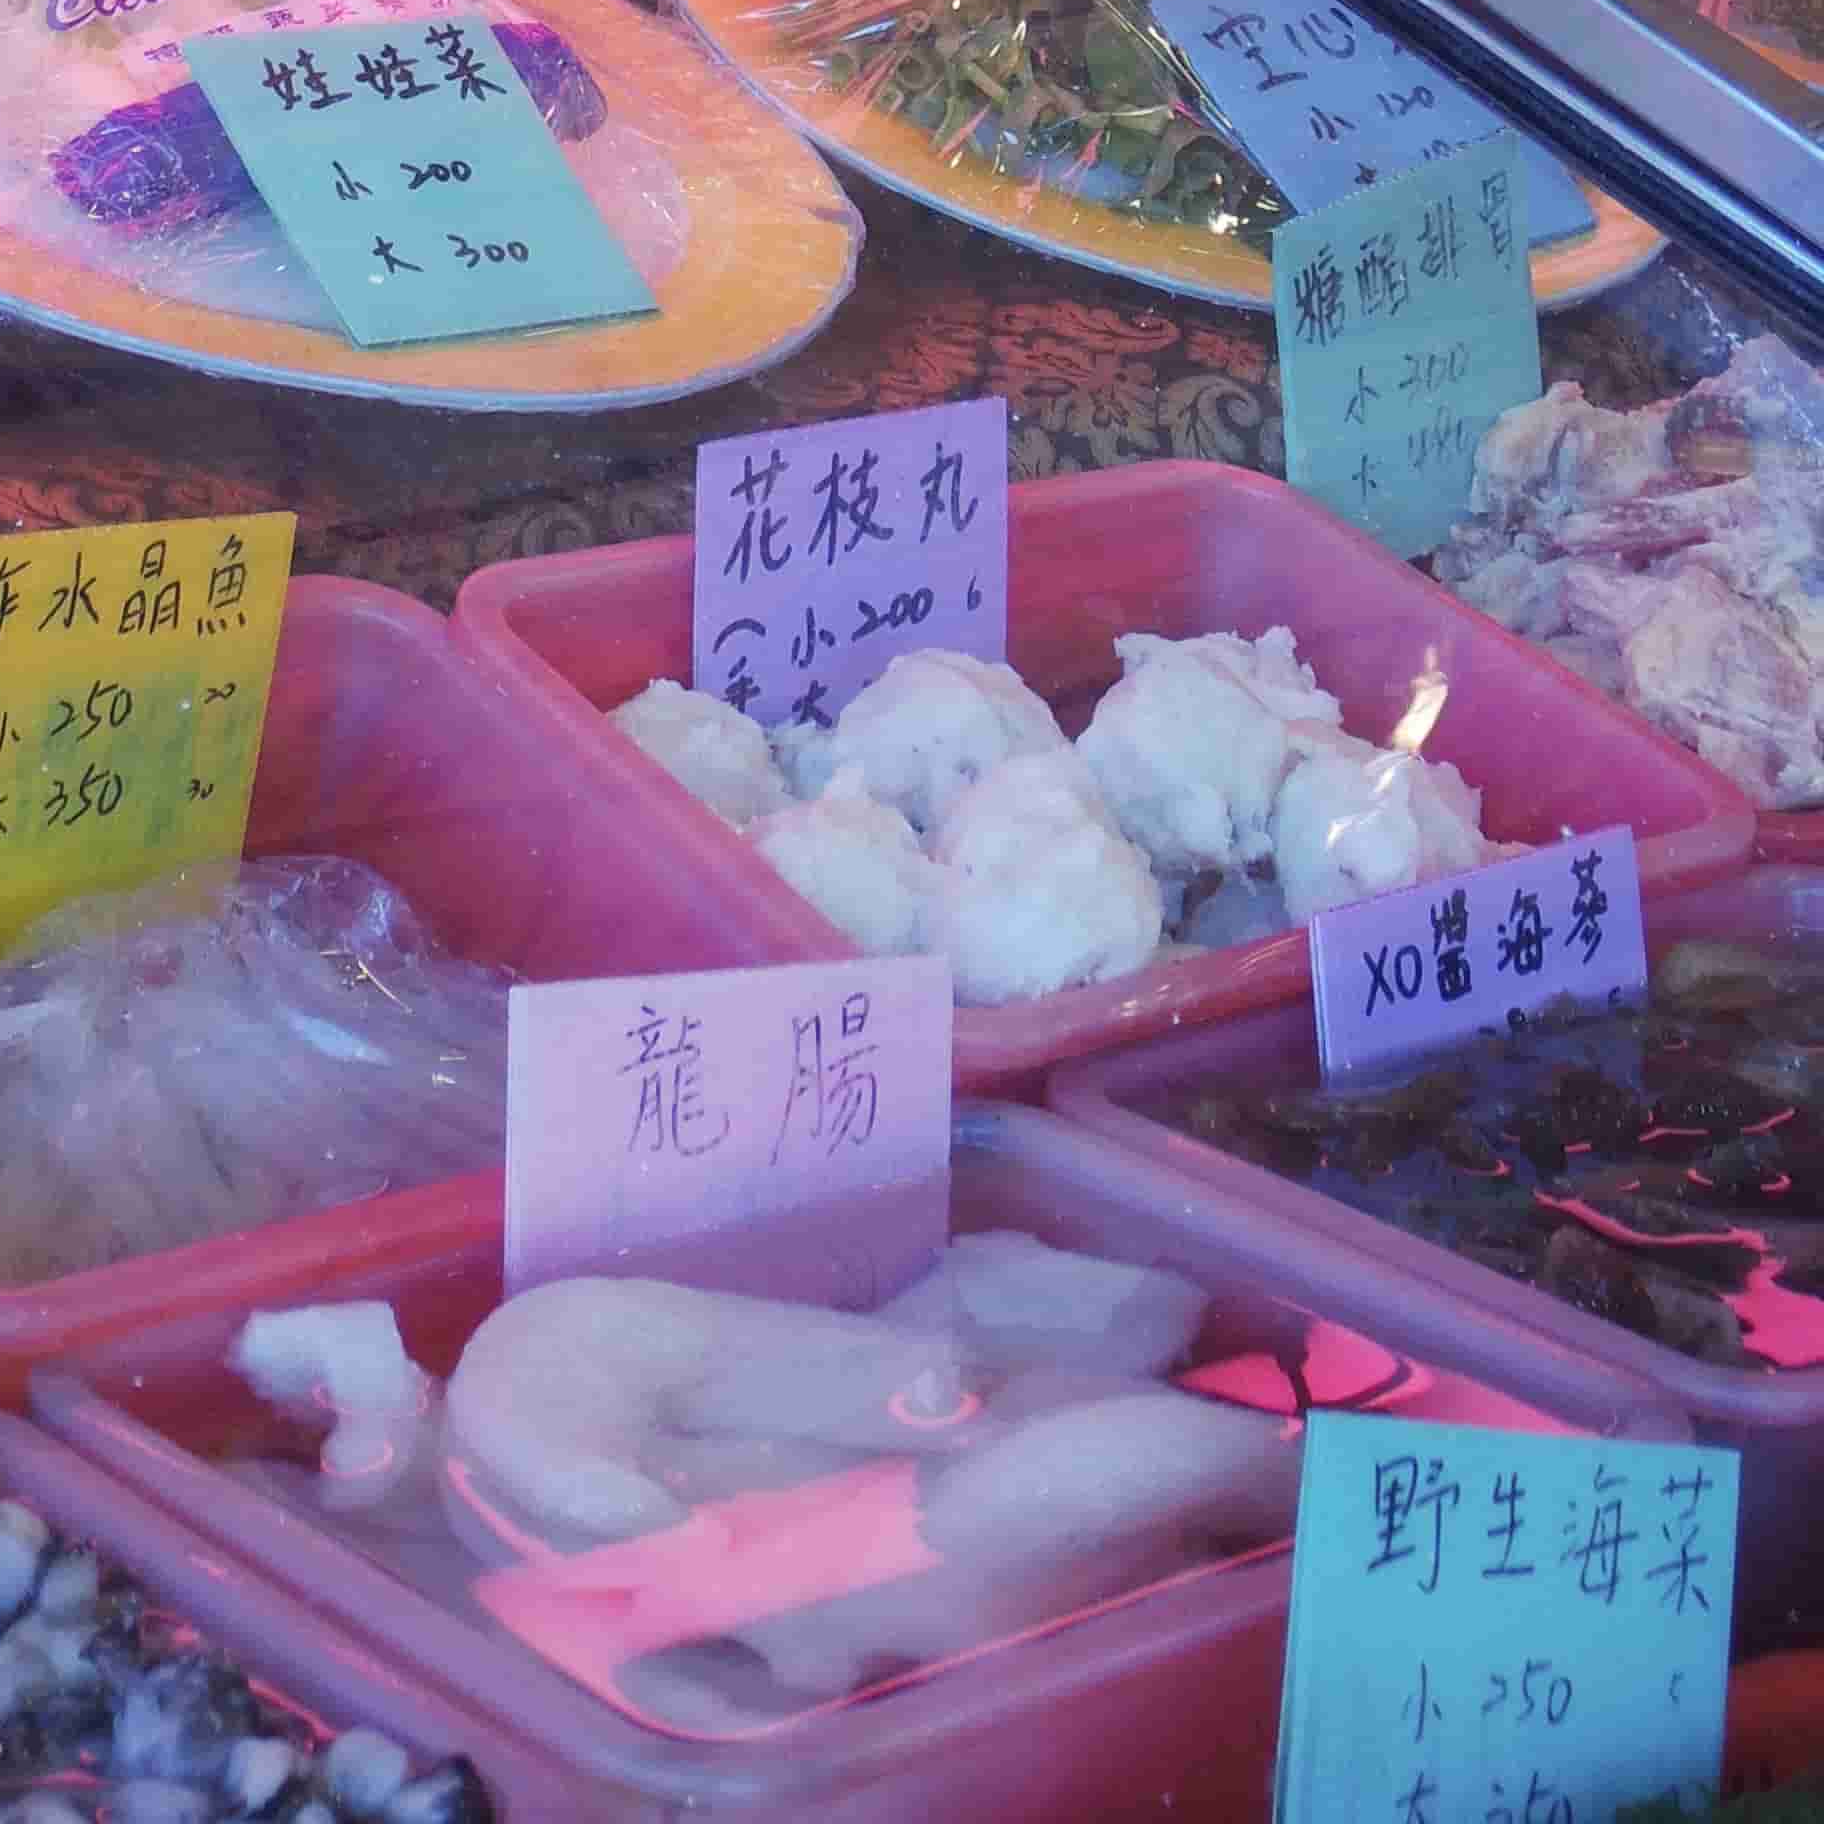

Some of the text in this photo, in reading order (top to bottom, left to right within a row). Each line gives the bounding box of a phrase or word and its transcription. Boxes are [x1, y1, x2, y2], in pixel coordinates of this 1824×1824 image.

[261, 25, 507, 113] 娃娃菜
[334, 156, 473, 202] 小 200
[370, 233, 531, 275] 大 300
[723, 441, 979, 585] 花枝丸
[791, 605, 837, 669] 小
[850, 587, 936, 644] 200
[49, 679, 134, 743] 250
[44, 763, 124, 828] 350
[615, 991, 880, 1168] 龍腸
[1366, 1455, 1714, 1617] 野生海菜
[1402, 1658, 1444, 1745] 小
[1480, 1657, 1574, 1727] 250
